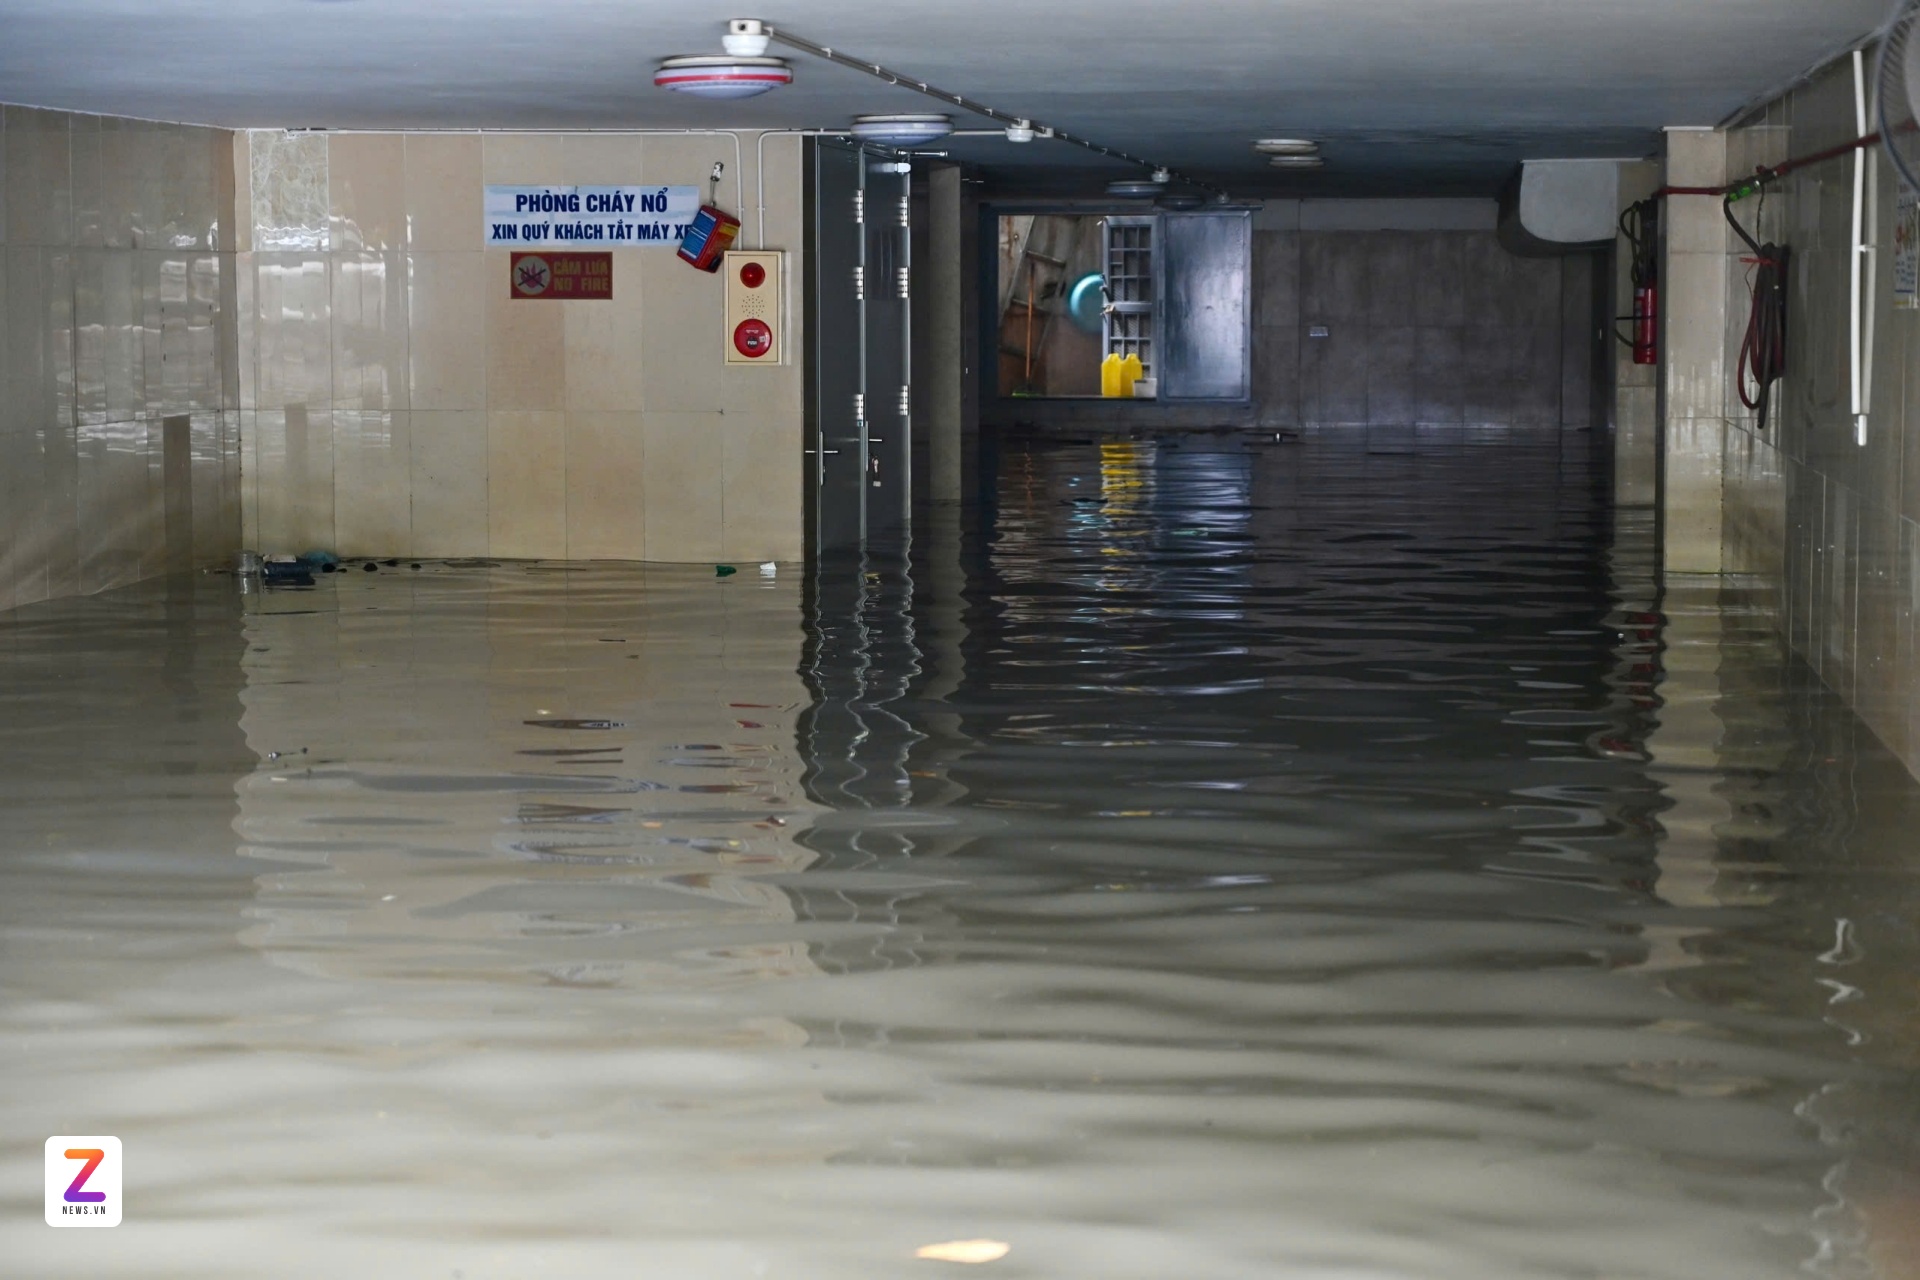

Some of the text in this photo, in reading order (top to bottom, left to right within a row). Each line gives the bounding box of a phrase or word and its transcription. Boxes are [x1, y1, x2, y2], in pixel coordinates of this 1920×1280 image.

[516, 187, 668, 212] PHÒNG CHÁY NỔ
[492, 224, 517, 239] XIN
[522, 221, 550, 241] QUÝ
[555, 221, 603, 240] KHÁCH
[607, 219, 633, 240] TẮT
[637, 221, 670, 240] MÁY
[553, 278, 608, 291] NO FIRE
